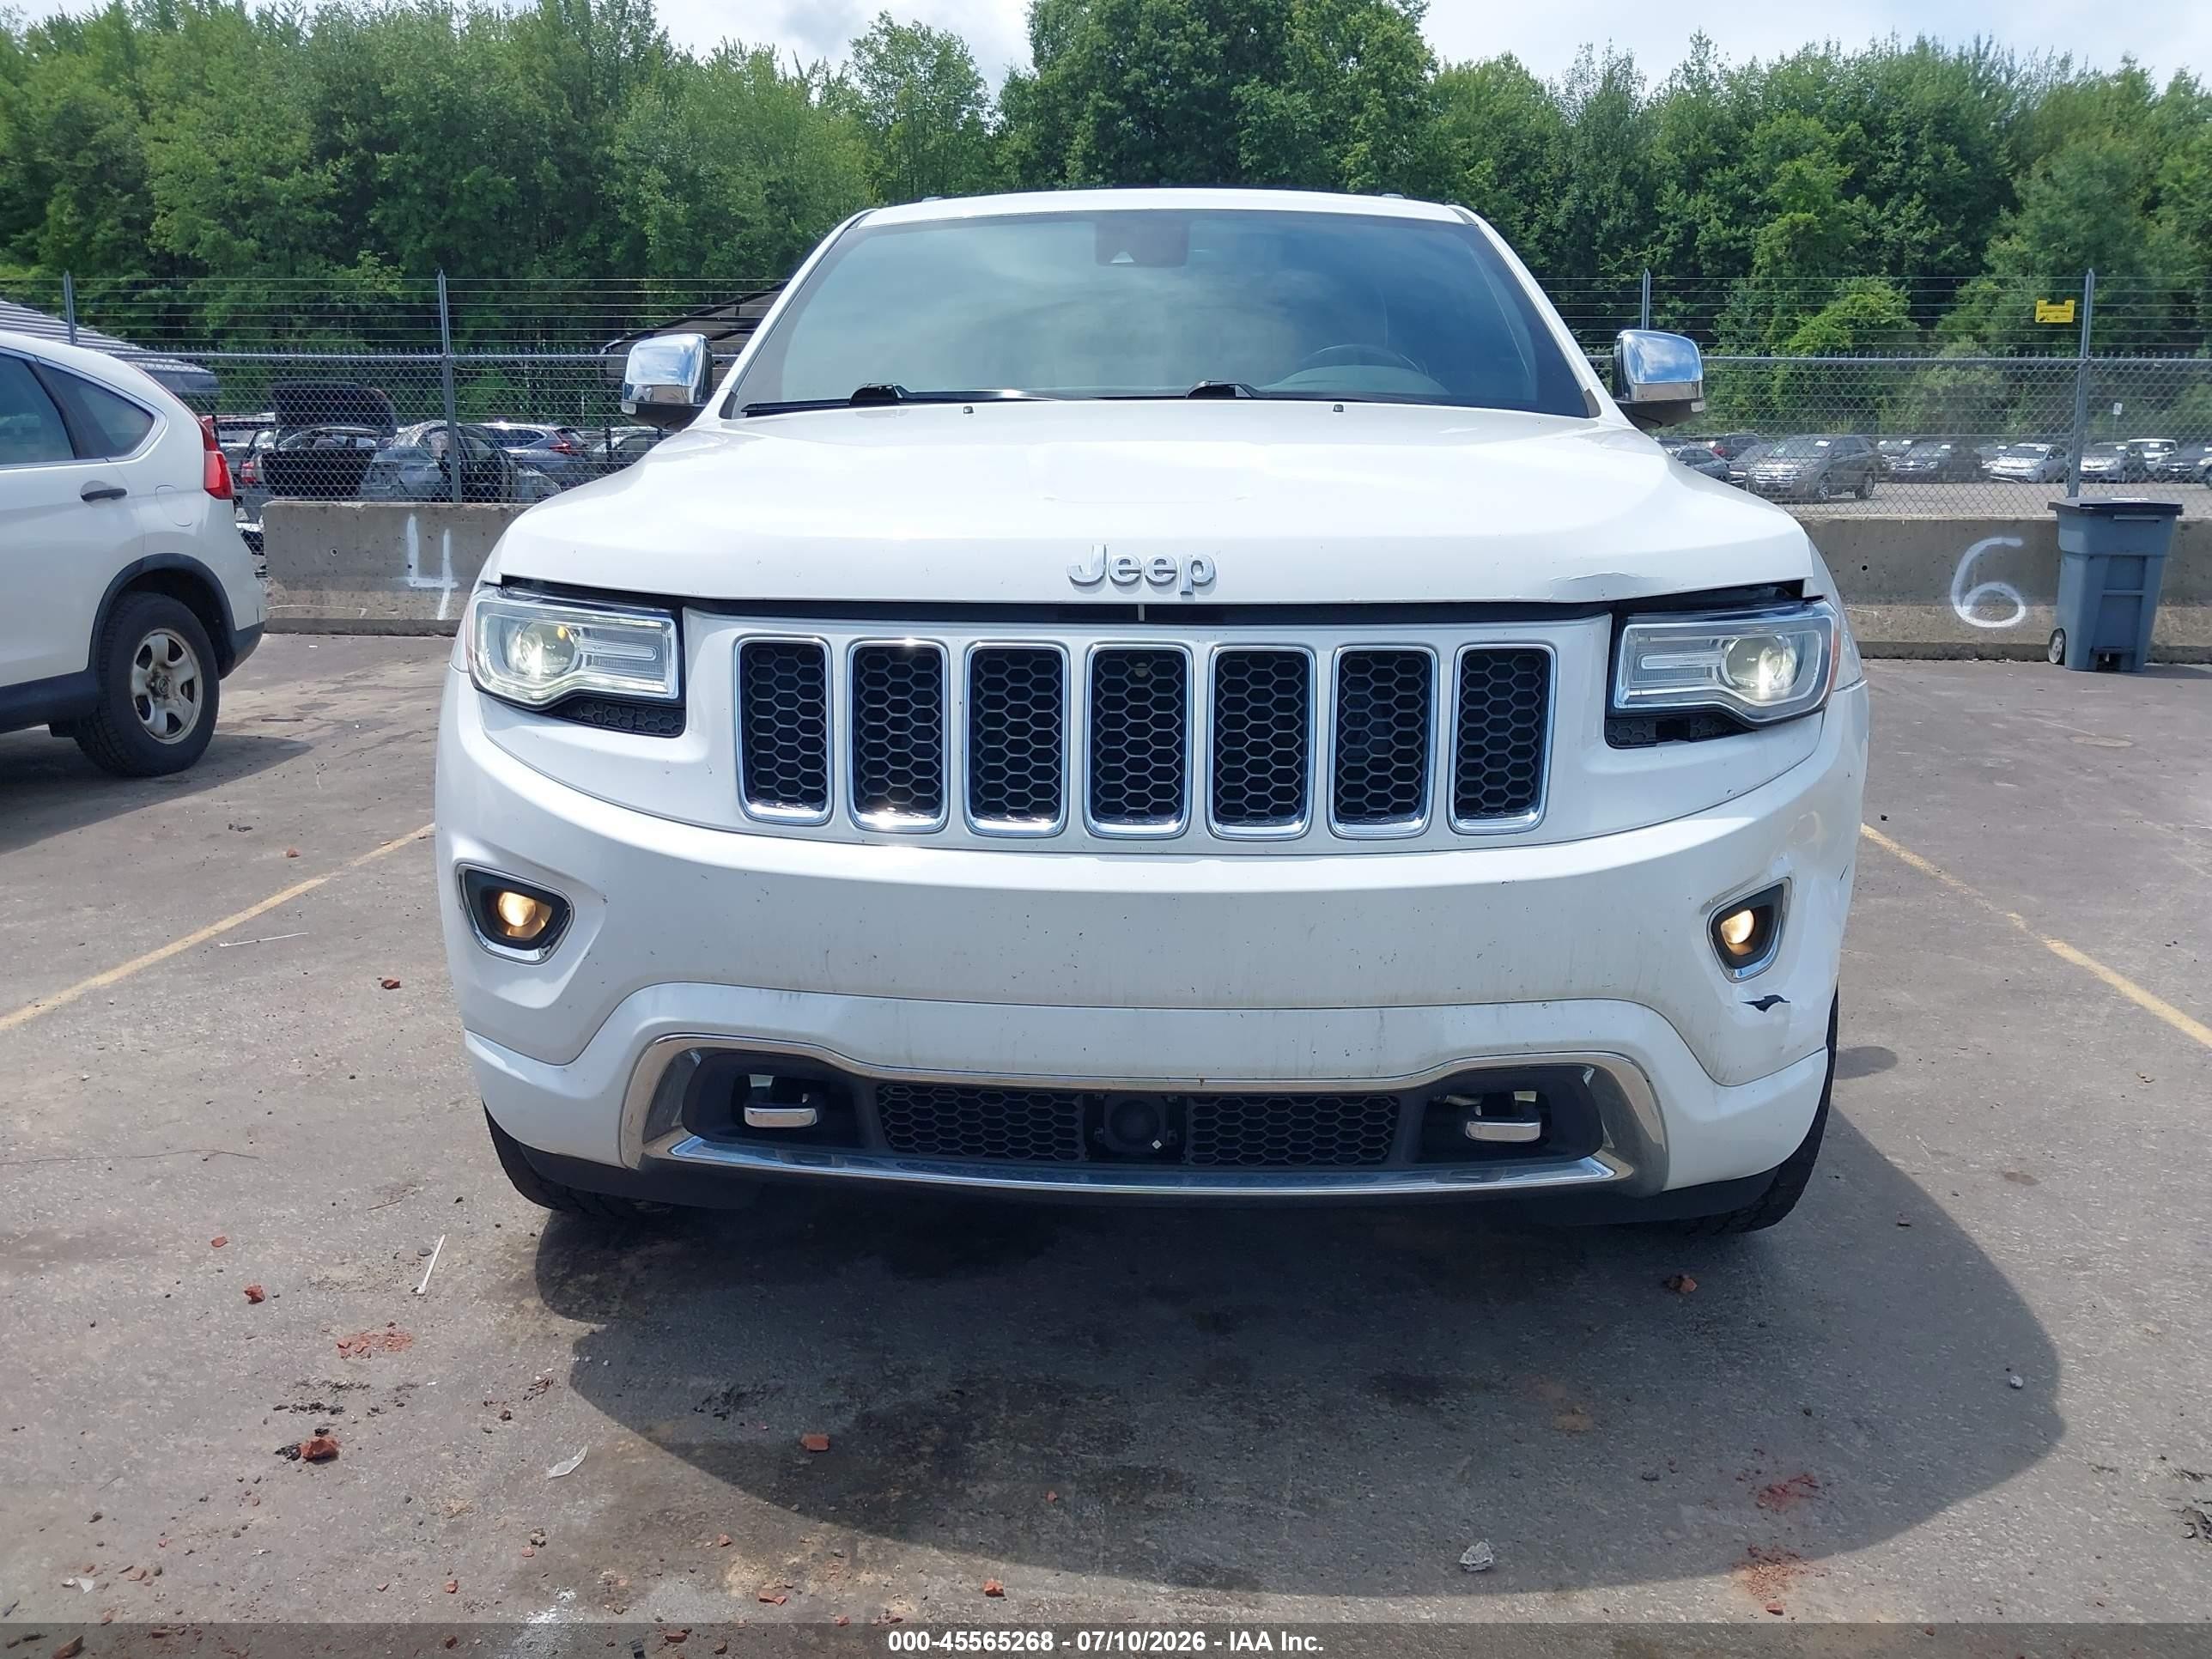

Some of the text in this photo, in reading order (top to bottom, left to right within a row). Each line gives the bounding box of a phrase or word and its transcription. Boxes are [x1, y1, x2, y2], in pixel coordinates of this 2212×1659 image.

[406, 514, 459, 620] 4
[1067, 544, 1216, 595] Jeep
[1951, 537, 2026, 628] 6
